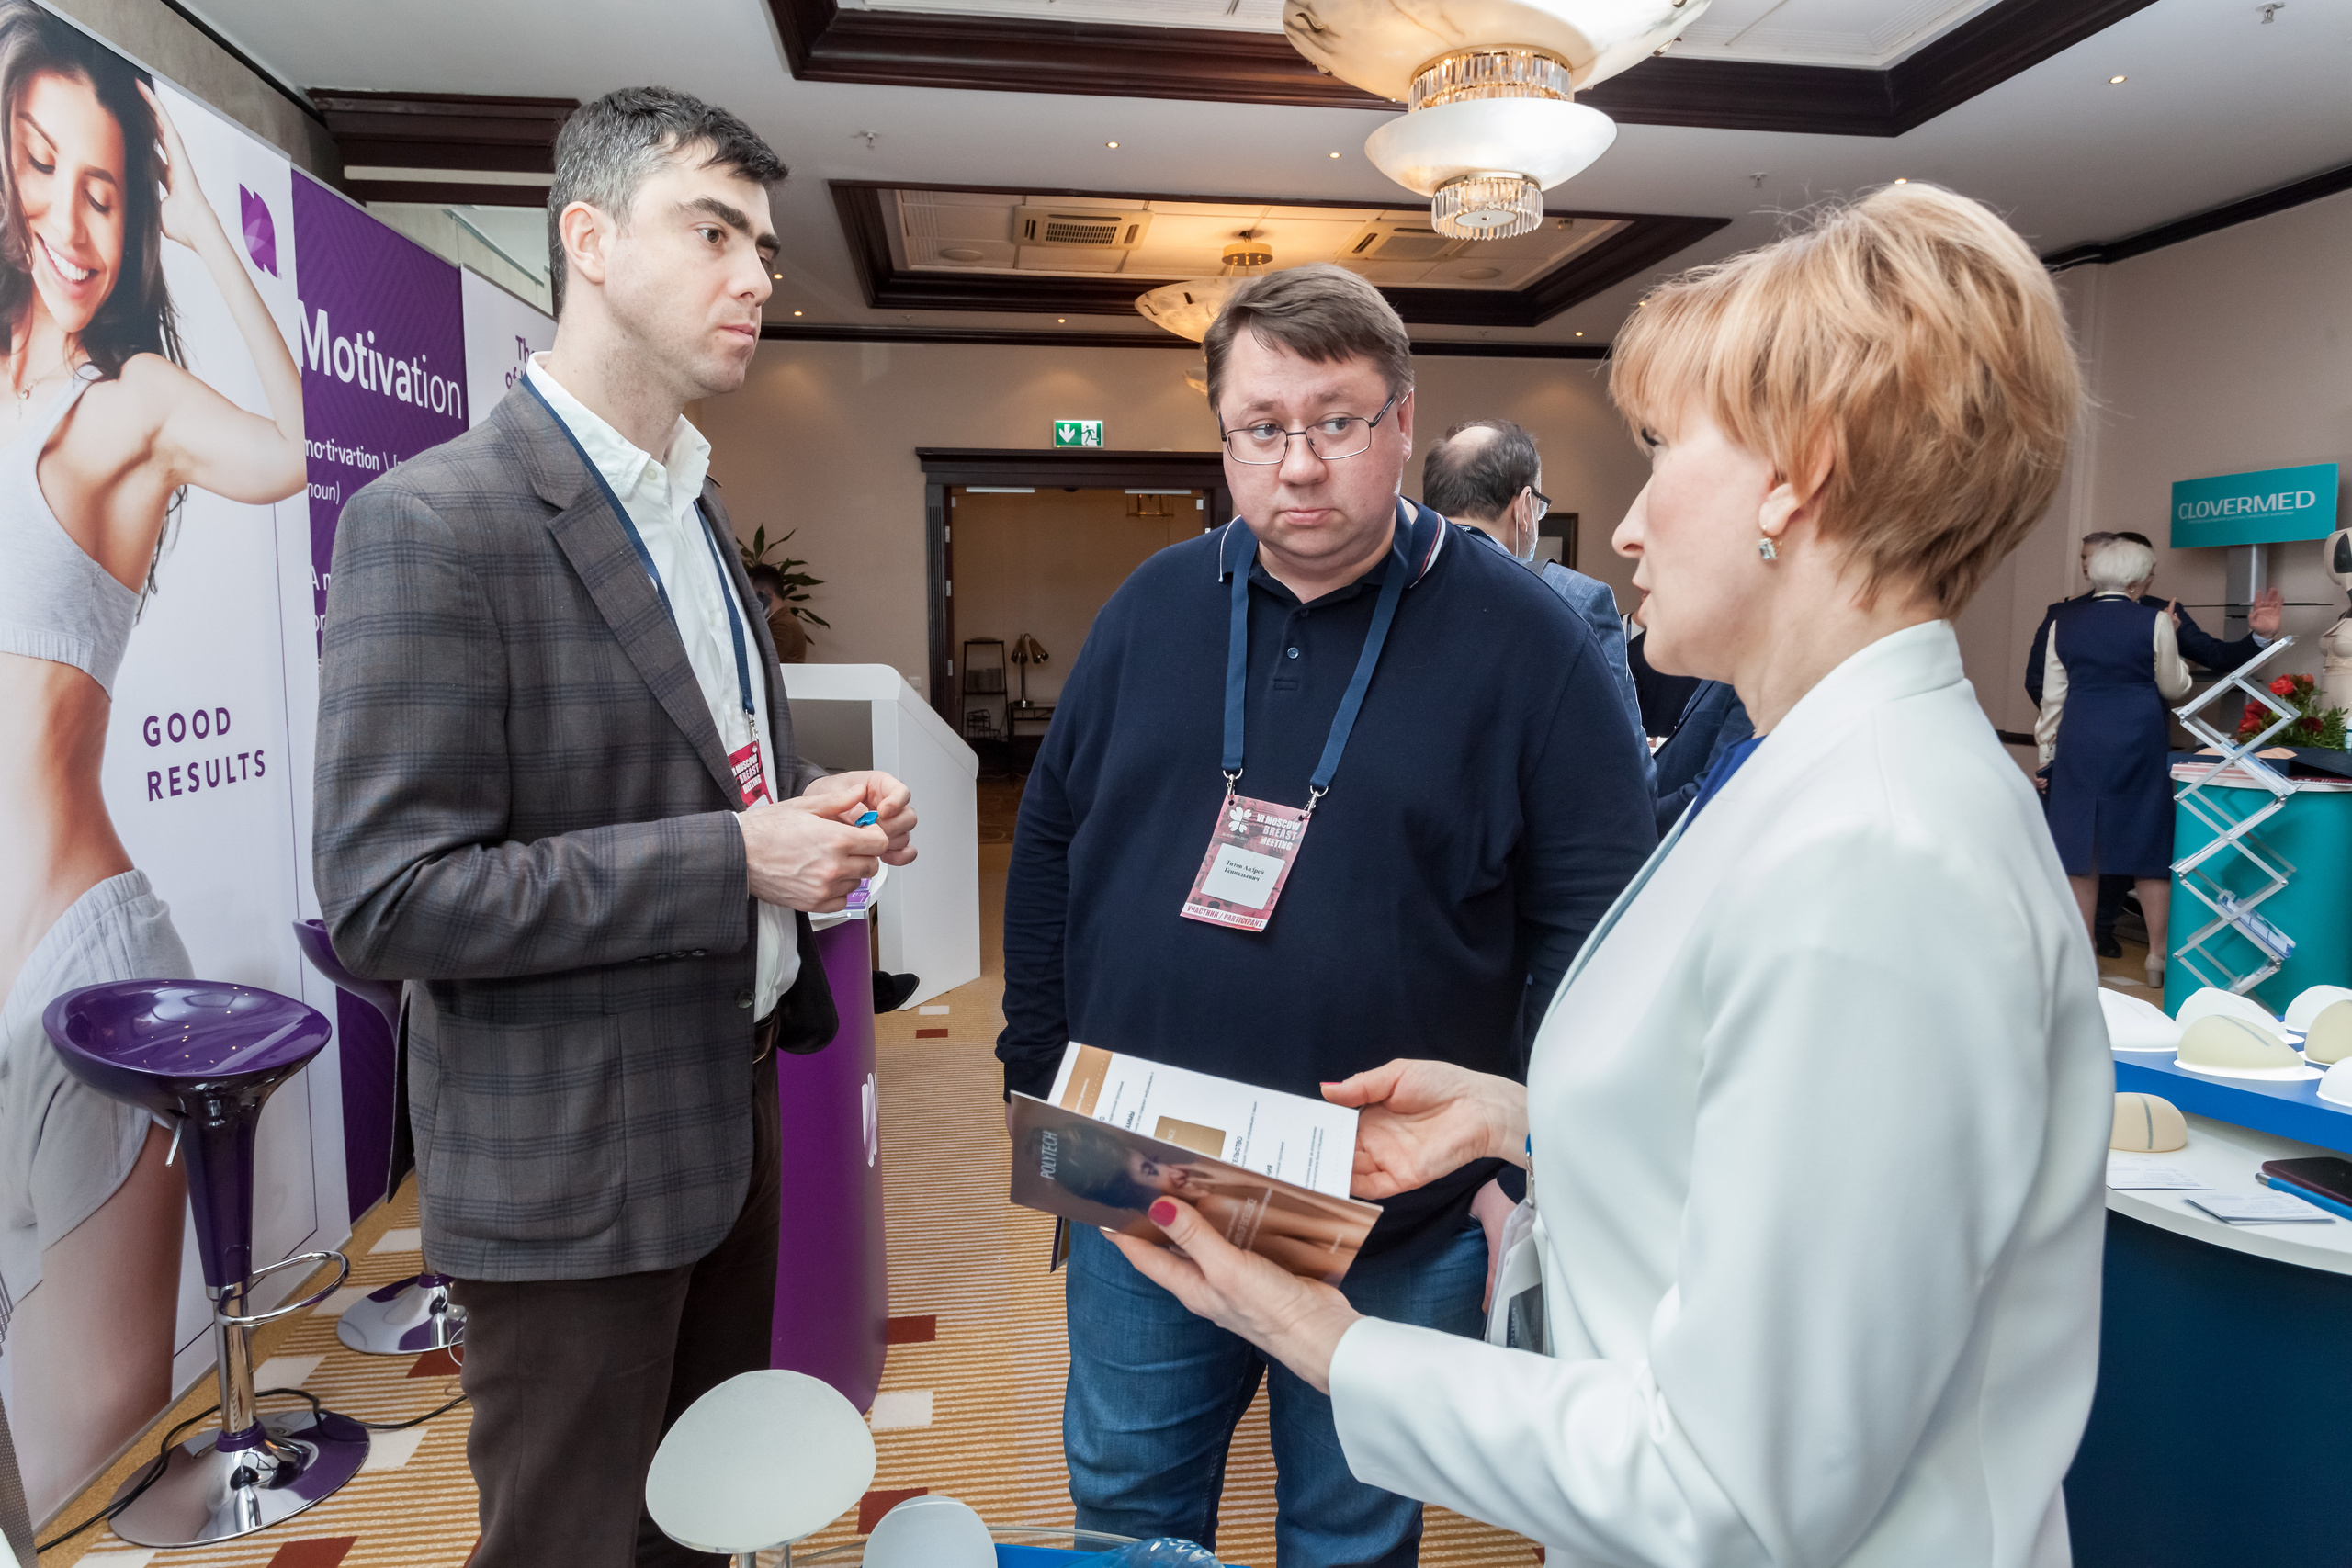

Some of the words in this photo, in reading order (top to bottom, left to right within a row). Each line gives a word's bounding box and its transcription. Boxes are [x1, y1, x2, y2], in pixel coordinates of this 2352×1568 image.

[298, 299, 461, 420] Motivation
[515, 334, 535, 364] Th
[307, 480, 341, 505] noun)
[2178, 491, 2316, 520] CLOVERMED
[143, 707, 231, 747] GOOD
[147, 750, 266, 802] RESULTS
[738, 762, 760, 784] BREAST
[742, 774, 763, 795] MEETING
[1256, 814, 1265, 823] VI
[1265, 816, 1301, 831] MOSCOW
[1262, 825, 1297, 841] BREAST
[1260, 835, 1294, 851] MEETING
[1223, 913, 1263, 928] PARTICIPANT
[1040, 1130, 1057, 1180] POLYTECH
